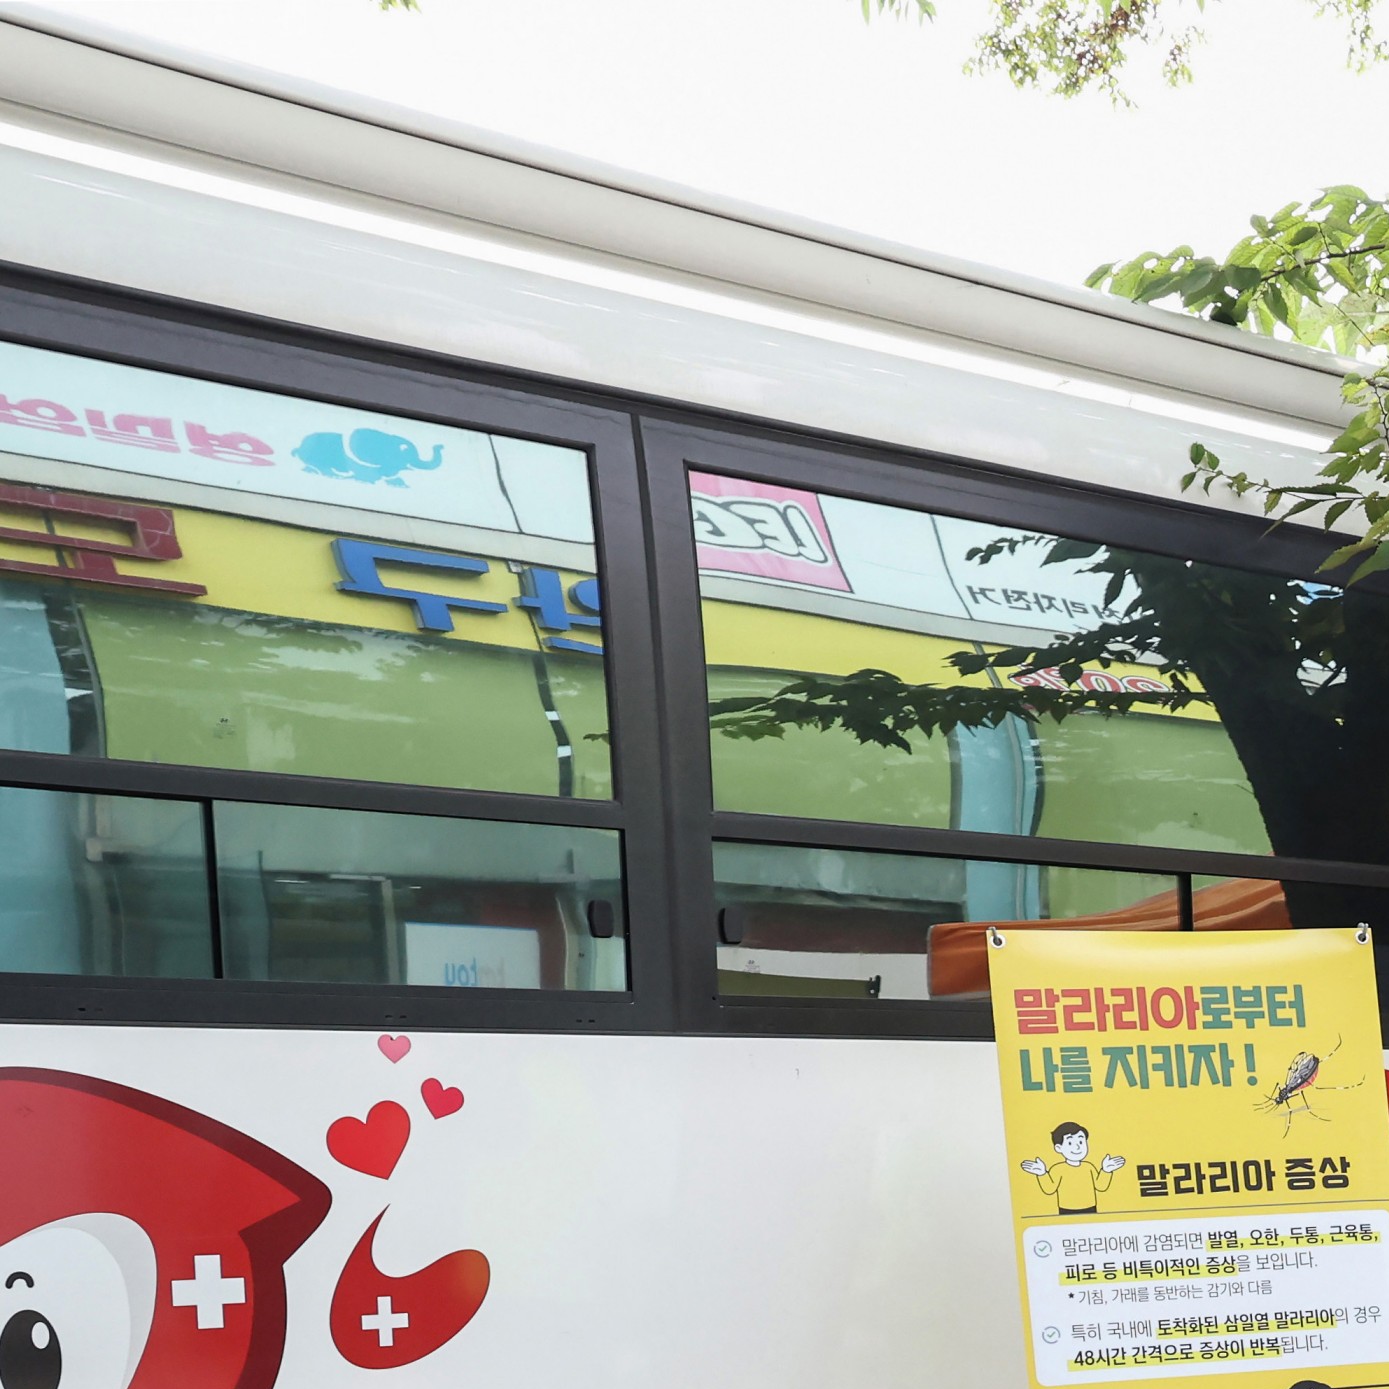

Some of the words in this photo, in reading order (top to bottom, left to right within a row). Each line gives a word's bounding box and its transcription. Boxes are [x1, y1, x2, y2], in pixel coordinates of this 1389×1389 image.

[1014, 984, 1306, 1034] 말라리아로부터
[1019, 1047, 1093, 1093] 나를
[1102, 1043, 1236, 1091] 지키자
[1137, 1161, 1275, 1198] 말라리아
[1284, 1156, 1351, 1191] 증상
[1062, 1235, 1139, 1256] 말라리아에
[1143, 1233, 1204, 1252] 감염되면
[1207, 1229, 1244, 1249] 발열,
[1249, 1228, 1285, 1247] 오한,
[1289, 1225, 1325, 1245] 두통,
[1329, 1223, 1379, 1244] 근육통,
[1065, 1263, 1097, 1282] 피로
[1102, 1263, 1118, 1280] 등
[1123, 1258, 1201, 1278] 비특이적인
[1205, 1255, 1251, 1274] 증상을
[1256, 1251, 1318, 1272] 보입니다.
[1078, 1288, 1108, 1306] 기침,
[1111, 1286, 1149, 1304] 가래를
[1153, 1282, 1204, 1301] 동반하는
[1207, 1281, 1244, 1299] 감기와
[1248, 1279, 1273, 1296] 다름
[1071, 1323, 1101, 1341] 특히
[1106, 1319, 1153, 1339] 국내에
[1157, 1316, 1219, 1337] 토착화된
[1223, 1313, 1269, 1332] 삼일열
[1274, 1308, 1349, 1328] 말라리아의
[1353, 1305, 1382, 1324] 경우
[1073, 1347, 1127, 1367] 48시간
[1131, 1343, 1194, 1363] 간격으로
[1199, 1338, 1245, 1359] 증상이
[1250, 1334, 1328, 1356] 반복됩니다.
